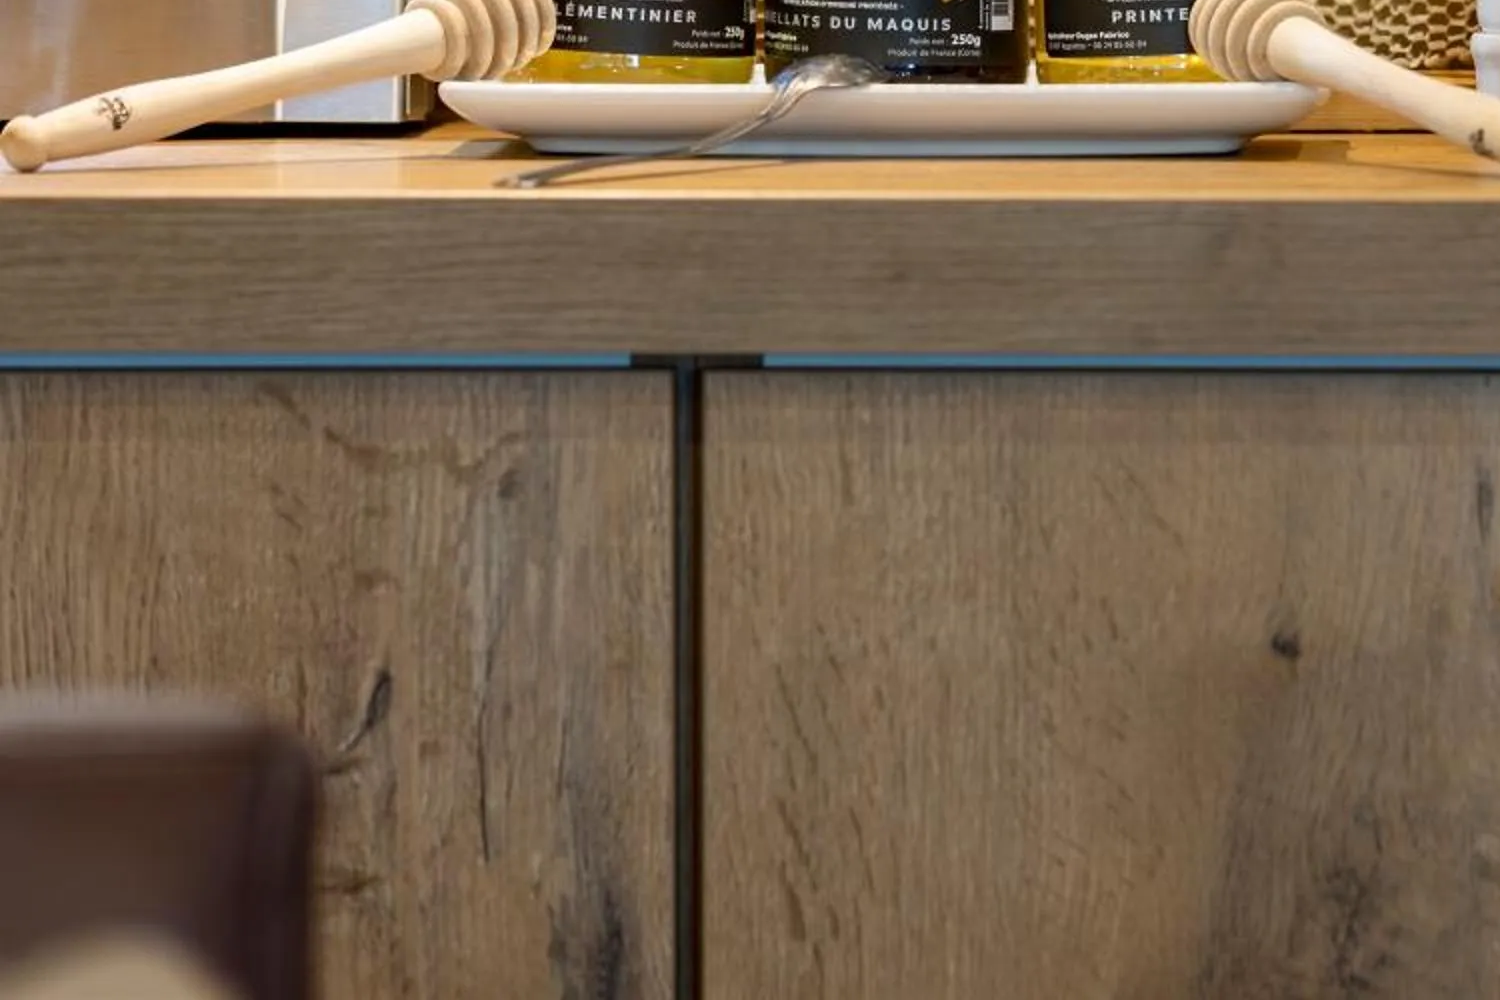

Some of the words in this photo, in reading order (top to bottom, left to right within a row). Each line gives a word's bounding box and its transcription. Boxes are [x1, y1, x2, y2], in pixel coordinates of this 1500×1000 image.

[829, 14, 857, 30] DU
[866, 16, 952, 33] MAQUIS
[724, 25, 745, 41] 250g
[951, 32, 982, 49] 250g
